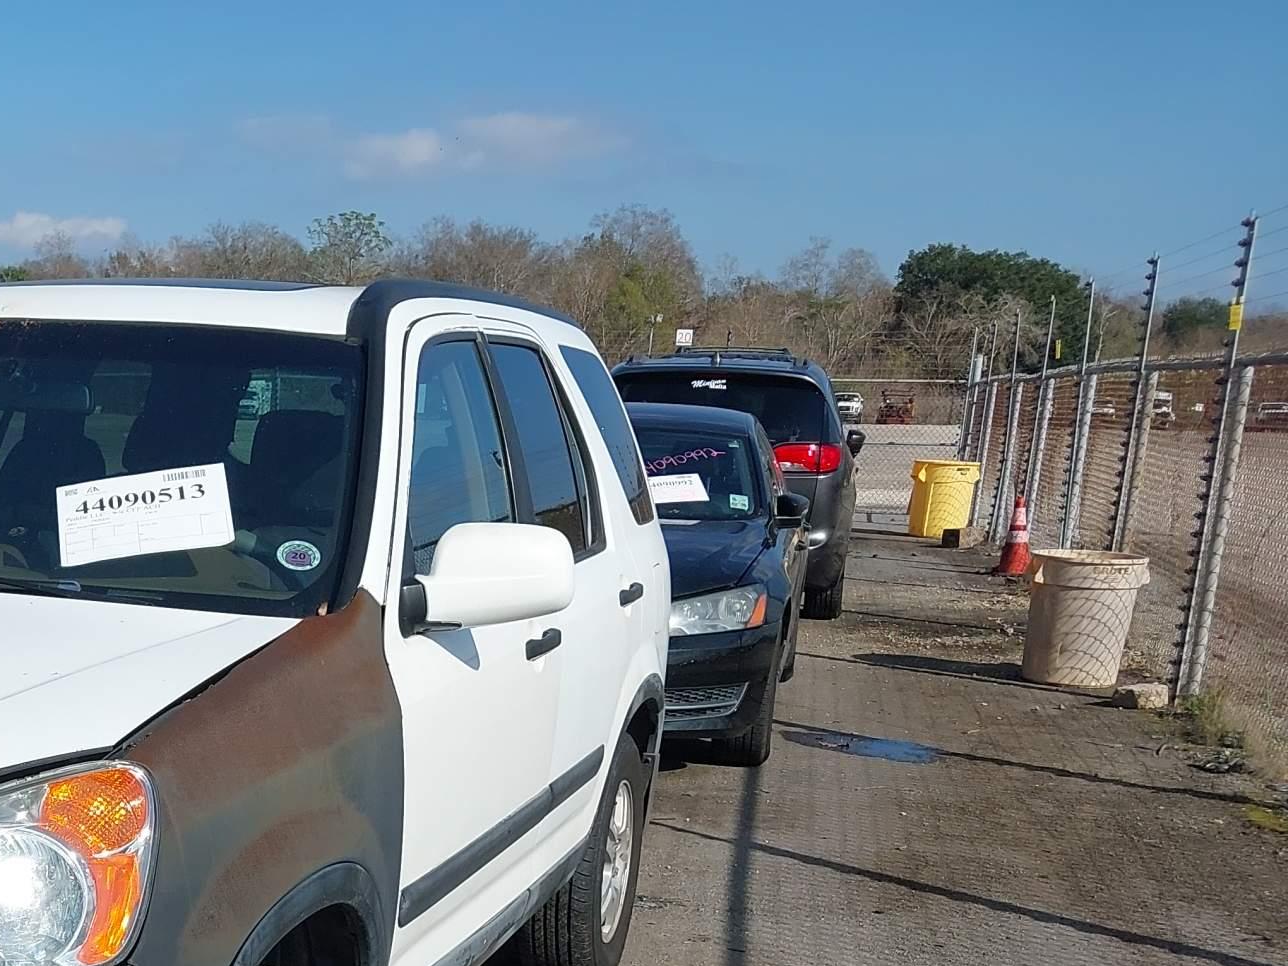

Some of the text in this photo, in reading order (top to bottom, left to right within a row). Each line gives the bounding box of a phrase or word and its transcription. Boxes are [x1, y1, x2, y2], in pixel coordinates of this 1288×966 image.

[678, 331, 692, 343] 20
[646, 447, 727, 473] 4090992
[75, 483, 206, 514] 44090513
[291, 552, 306, 560] 20
